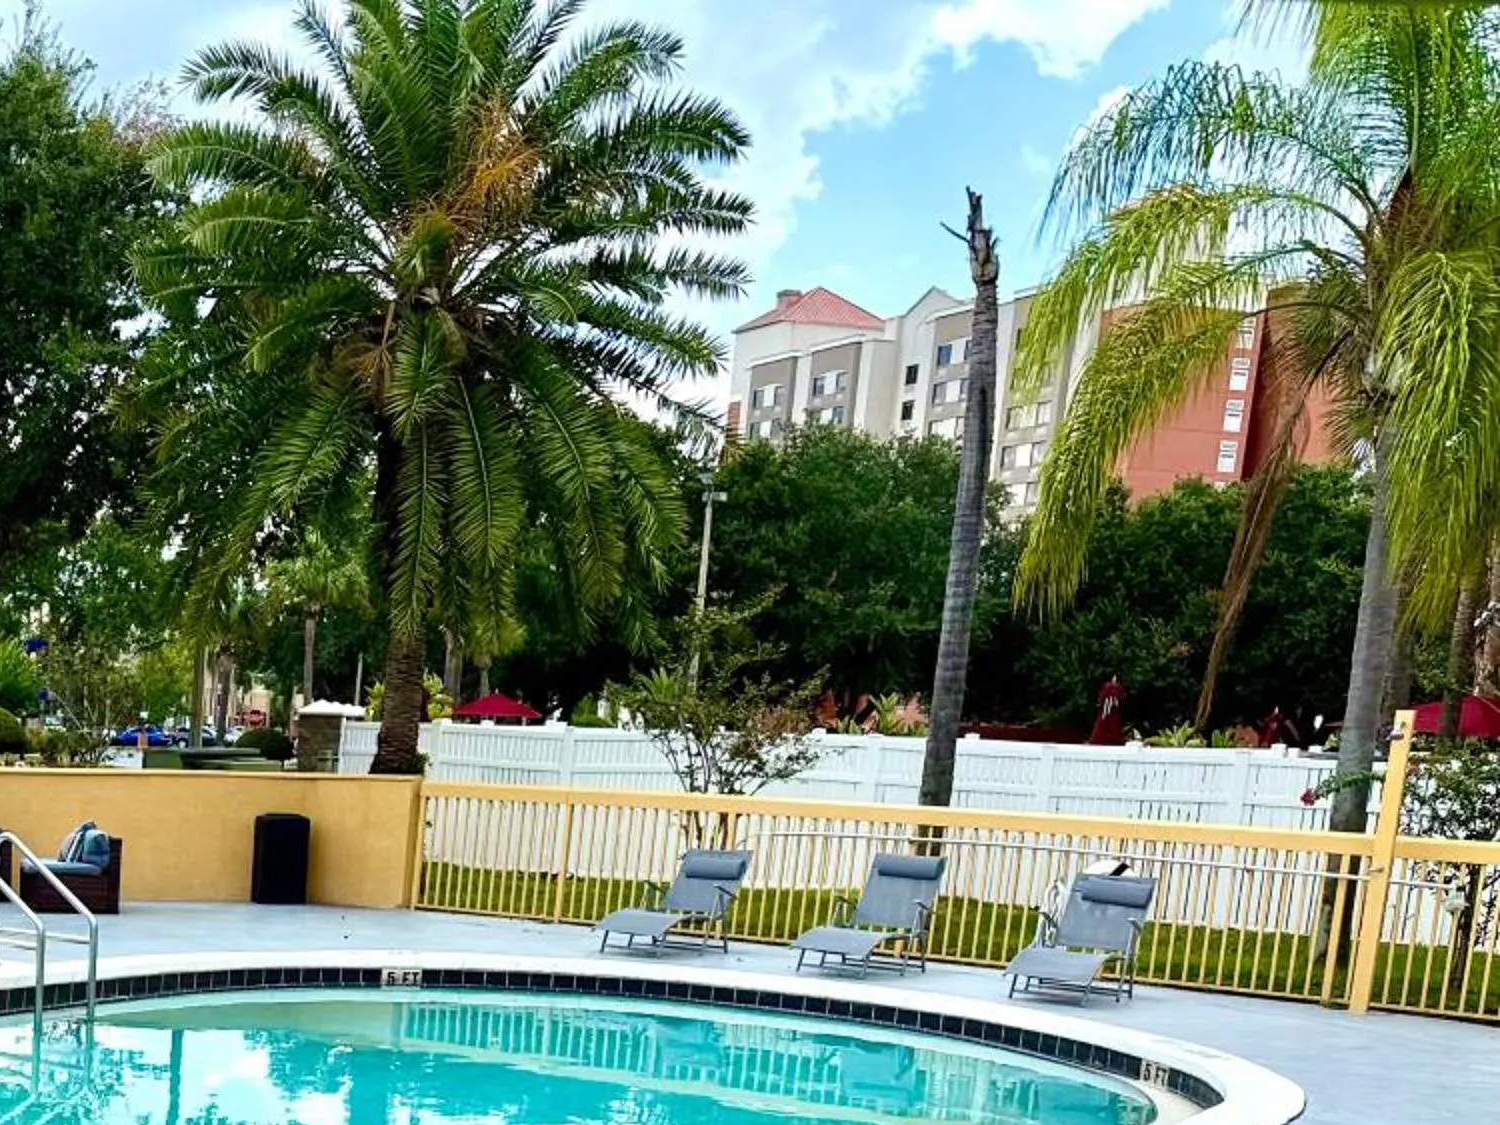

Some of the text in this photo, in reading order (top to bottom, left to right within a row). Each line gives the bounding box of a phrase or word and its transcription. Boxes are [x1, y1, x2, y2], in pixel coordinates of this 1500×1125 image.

[387, 971, 420, 985] 5 FT
[1144, 1063, 1167, 1086] 5 FT
